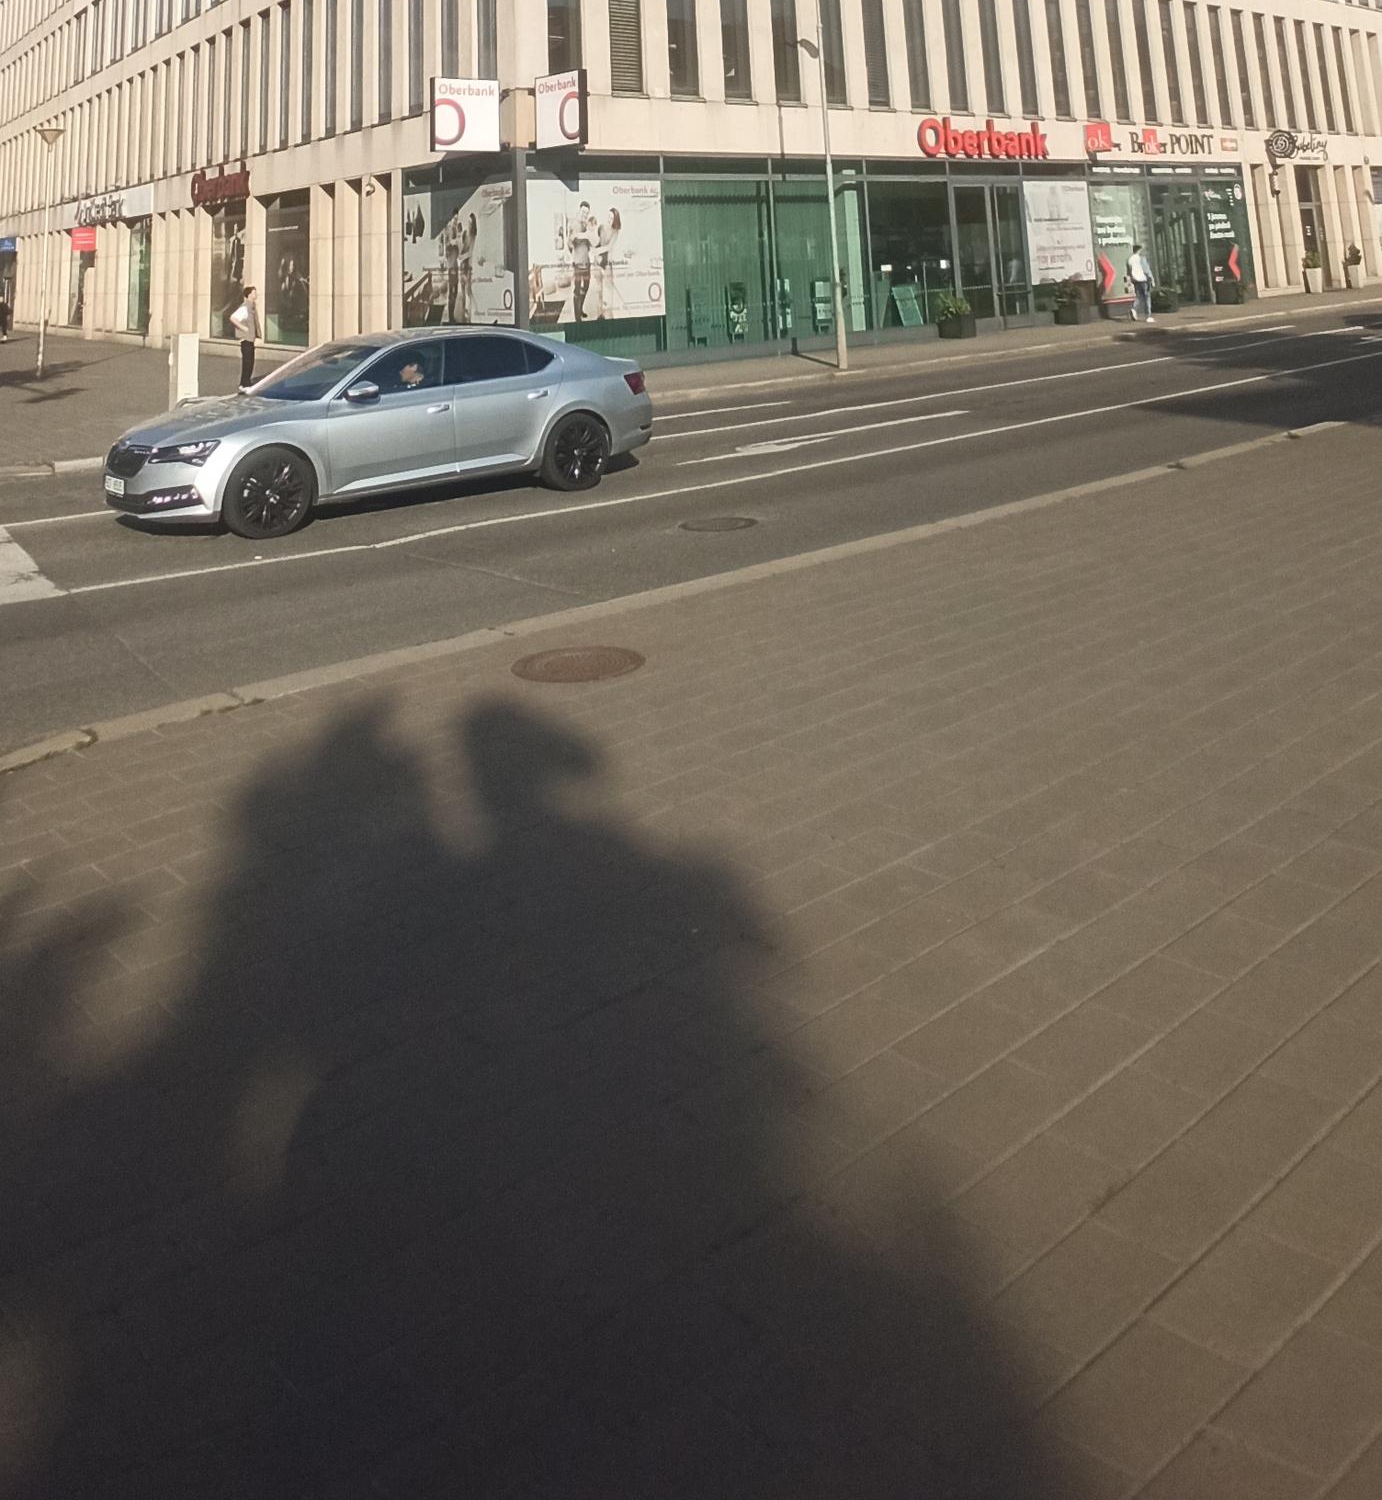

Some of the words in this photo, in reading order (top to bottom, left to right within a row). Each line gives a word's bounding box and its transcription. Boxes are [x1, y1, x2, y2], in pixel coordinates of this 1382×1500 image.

[438, 83, 495, 97] Oberbank
[538, 76, 577, 94] Oberbank
[917, 116, 1050, 159] Oberbank
[1168, 134, 1214, 155] POINT
